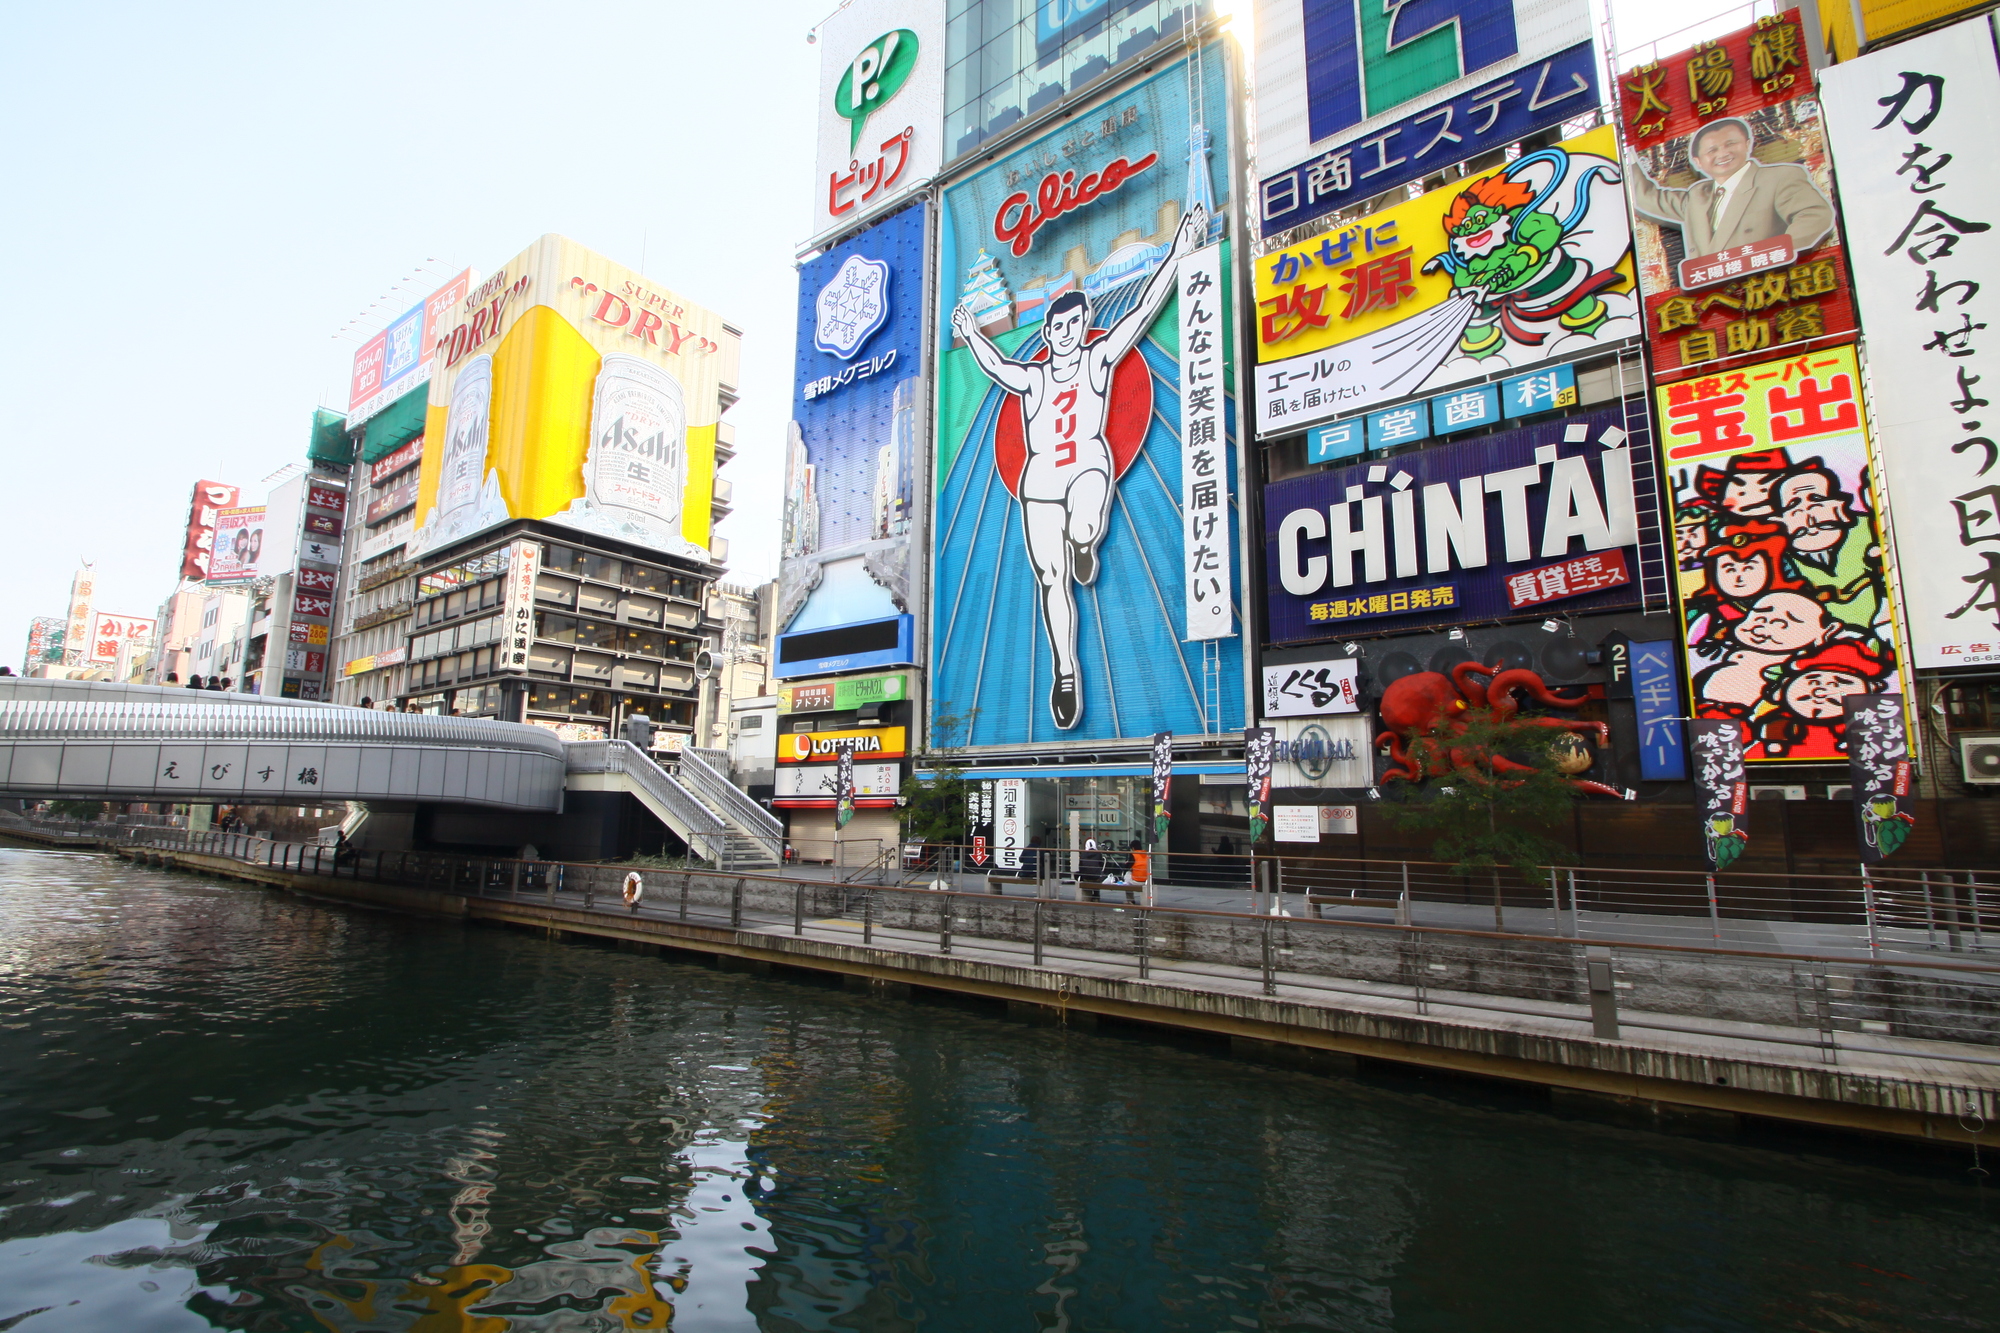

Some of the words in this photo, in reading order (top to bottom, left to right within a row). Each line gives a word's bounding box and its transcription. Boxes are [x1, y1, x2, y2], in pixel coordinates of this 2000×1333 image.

[1006, 105, 1140, 187] おいしさと健康
[1263, 61, 1589, 221] 日商エステム
[829, 125, 914, 217] ピップ
[1270, 219, 1399, 286] かぜに
[432, 289, 457, 315] みんな
[464, 270, 506, 314] SUPER
[622, 280, 684, 320] SUPER
[1259, 244, 1419, 348] 改源
[1655, 256, 1839, 334] 食べ放題
[1678, 302, 1825, 361] 自助餐
[803, 349, 897, 400] 雪印メグミルク
[1267, 358, 1352, 394] エールの
[1667, 357, 1840, 406] 激安スーパー
[1267, 382, 1367, 419] 風を届けたい
[1318, 372, 1560, 456] 戸堂歯科
[1557, 390, 1574, 408] 3F
[1668, 372, 1859, 460] 玉出
[446, 414, 484, 467] Asahi
[601, 415, 677, 470] Asahi
[1052, 383, 1080, 468] グリコ
[1186, 270, 1222, 616] みんなに笑顔を届けたい。
[409, 438, 423, 460] 笑
[455, 459, 468, 480] 生
[614, 484, 661, 504] スーパードライ
[627, 461, 650, 483] 生
[300, 571, 334, 588] はや
[1508, 568, 1570, 606] 賃貸
[1567, 557, 1603, 578] 住宅
[1570, 568, 1626, 592] ニュース
[295, 597, 330, 615] はや
[1310, 586, 1454, 621] 毎週水曜日発売
[100, 619, 148, 638] かに
[795, 696, 831, 709] アドアド
[1637, 651, 1677, 766] ペンギンバー
[1877, 699, 1906, 760] ラーメン
[164, 761, 319, 786] えびす橋
[1162, 735, 1171, 777] ラーメン
[1258, 731, 1273, 776] ラーメン
[1718, 724, 1743, 780] ラーメン
[1004, 788, 1017, 818] 河童
